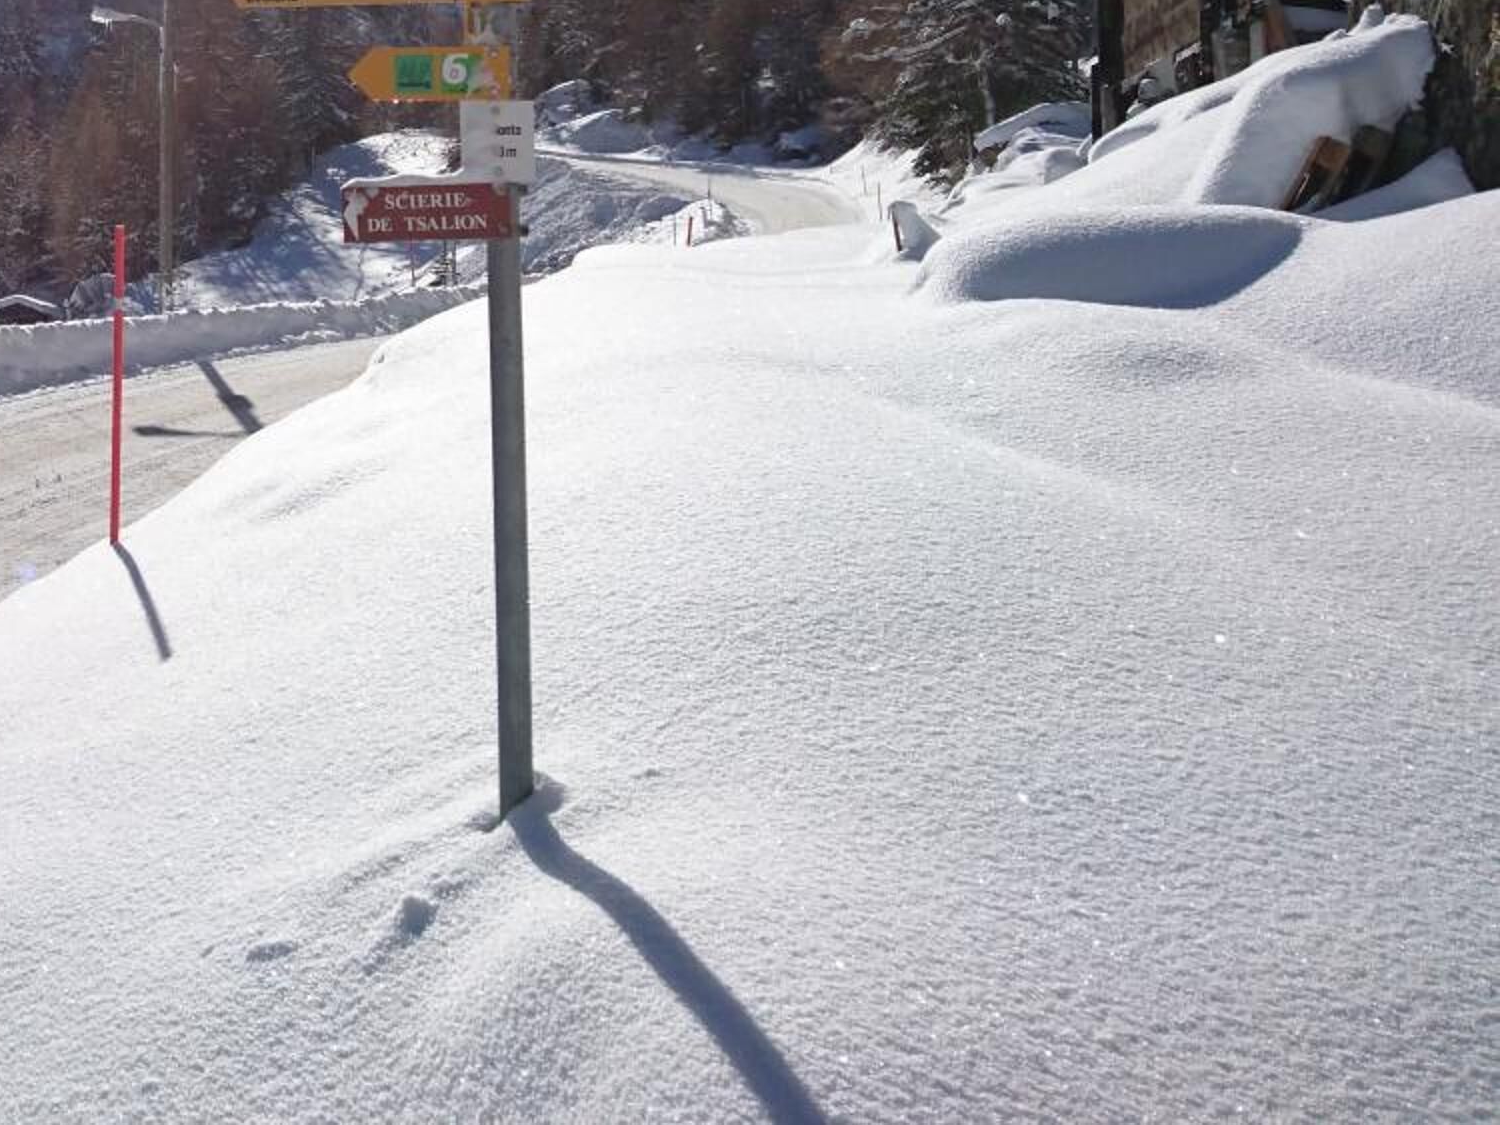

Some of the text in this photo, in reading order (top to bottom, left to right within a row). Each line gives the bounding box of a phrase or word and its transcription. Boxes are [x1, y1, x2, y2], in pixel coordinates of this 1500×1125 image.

[442, 53, 468, 85] 6
[384, 192, 467, 210] SCIERIE
[367, 214, 487, 232] DE TSALION
